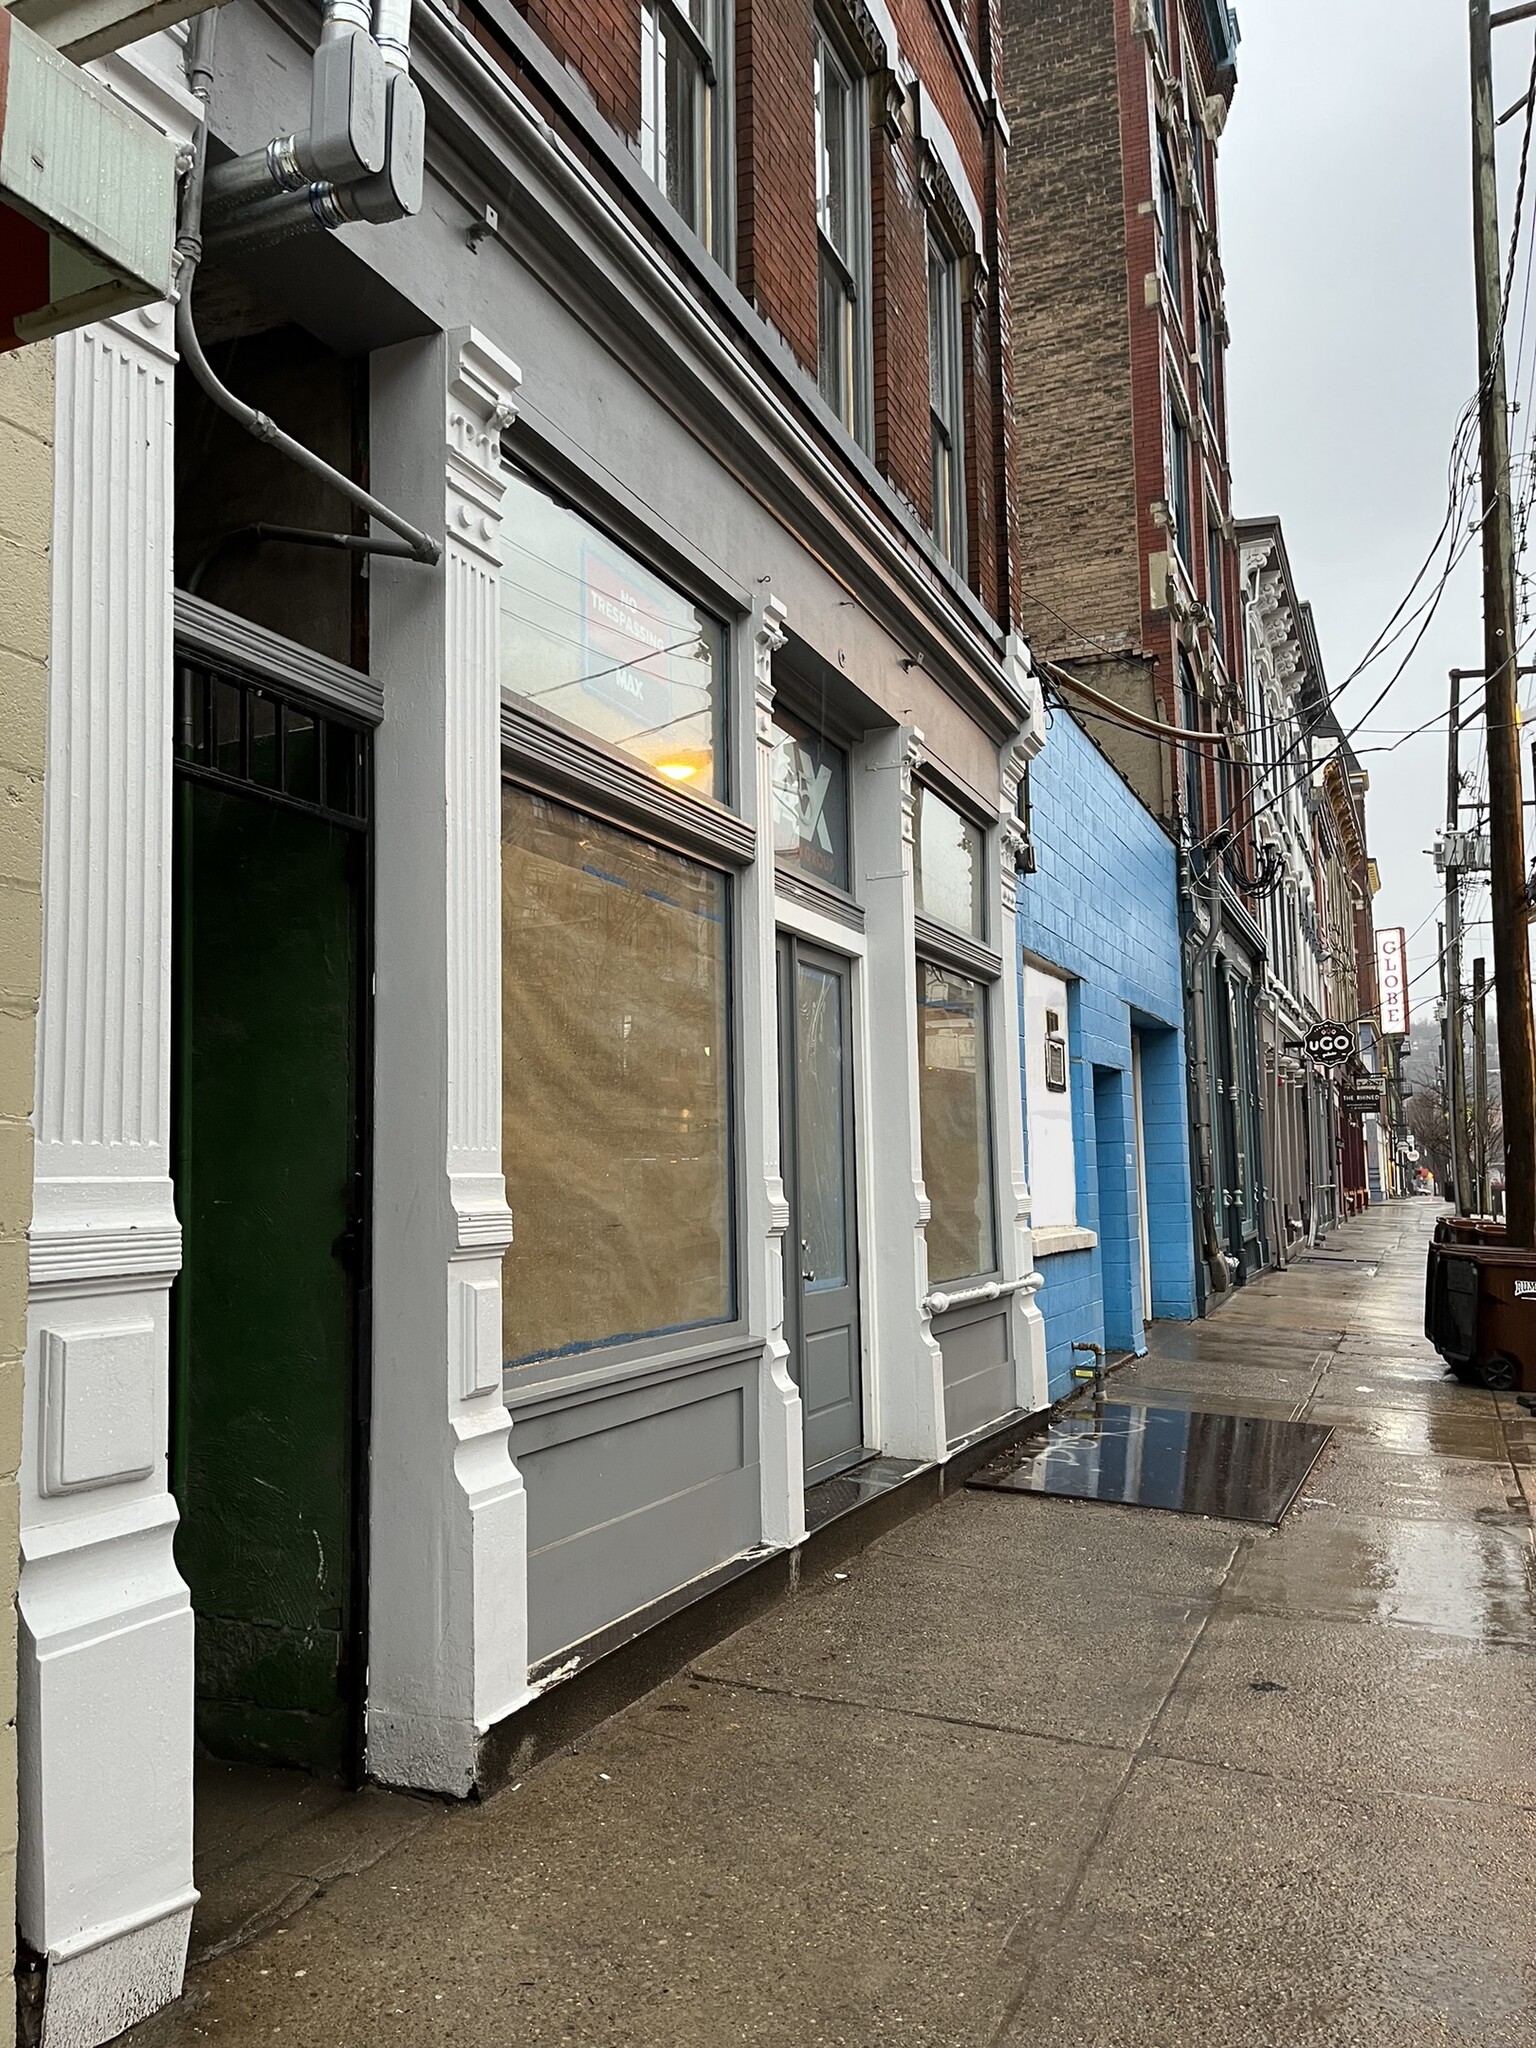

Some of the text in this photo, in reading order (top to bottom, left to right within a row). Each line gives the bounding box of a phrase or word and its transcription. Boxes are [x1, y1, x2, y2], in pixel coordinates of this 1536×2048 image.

[591, 590, 665, 651] TRESPASSING
[620, 589, 638, 614] NO
[615, 667, 644, 700] MAX
[1382, 941, 1400, 1023] GLOBE
